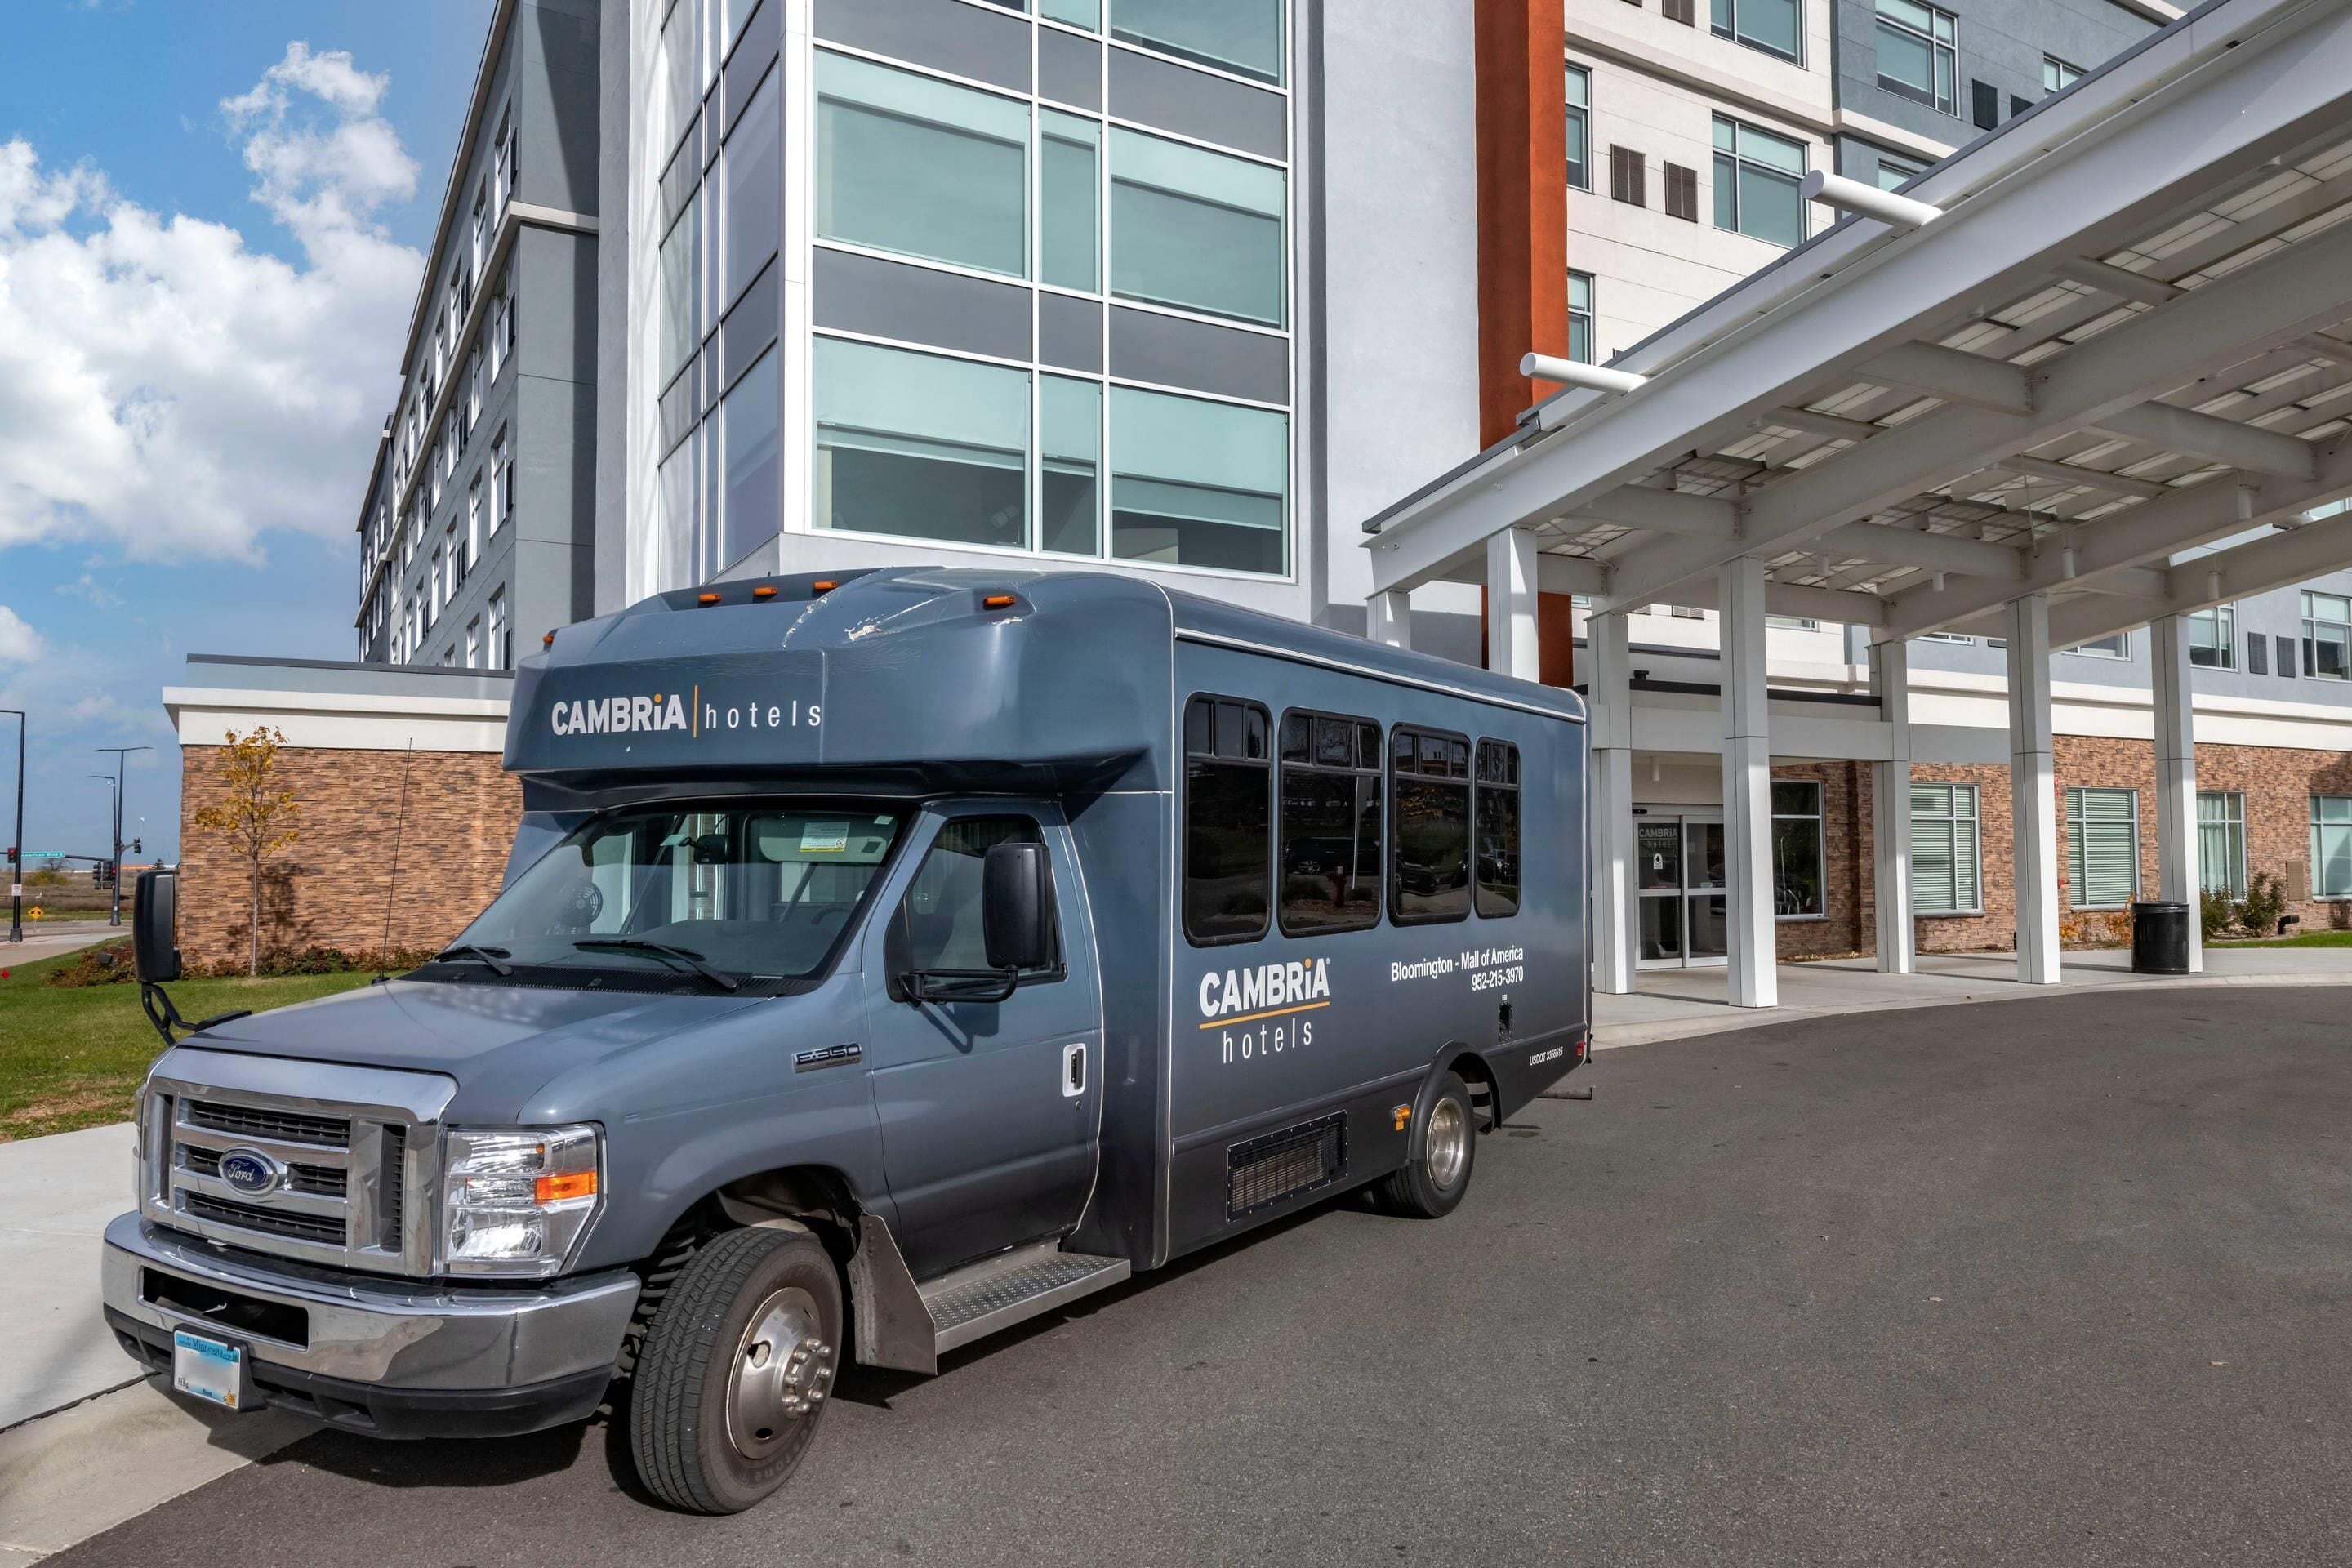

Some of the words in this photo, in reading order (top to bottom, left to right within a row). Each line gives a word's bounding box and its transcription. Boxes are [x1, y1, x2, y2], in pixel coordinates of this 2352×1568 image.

[705, 700, 822, 728] hotels
[1391, 957, 1453, 982] Bloomington
[1461, 950, 1479, 970] Mall
[1481, 948, 1490, 967] of
[1490, 944, 1523, 965] America
[1472, 965, 1524, 991] 952-215-3970
[1223, 1018, 1312, 1064] hotels
[1529, 1052, 1546, 1066] USDOT
[228, 1159, 256, 1182] Ford
[192, 1339, 223, 1356] Minnesota
